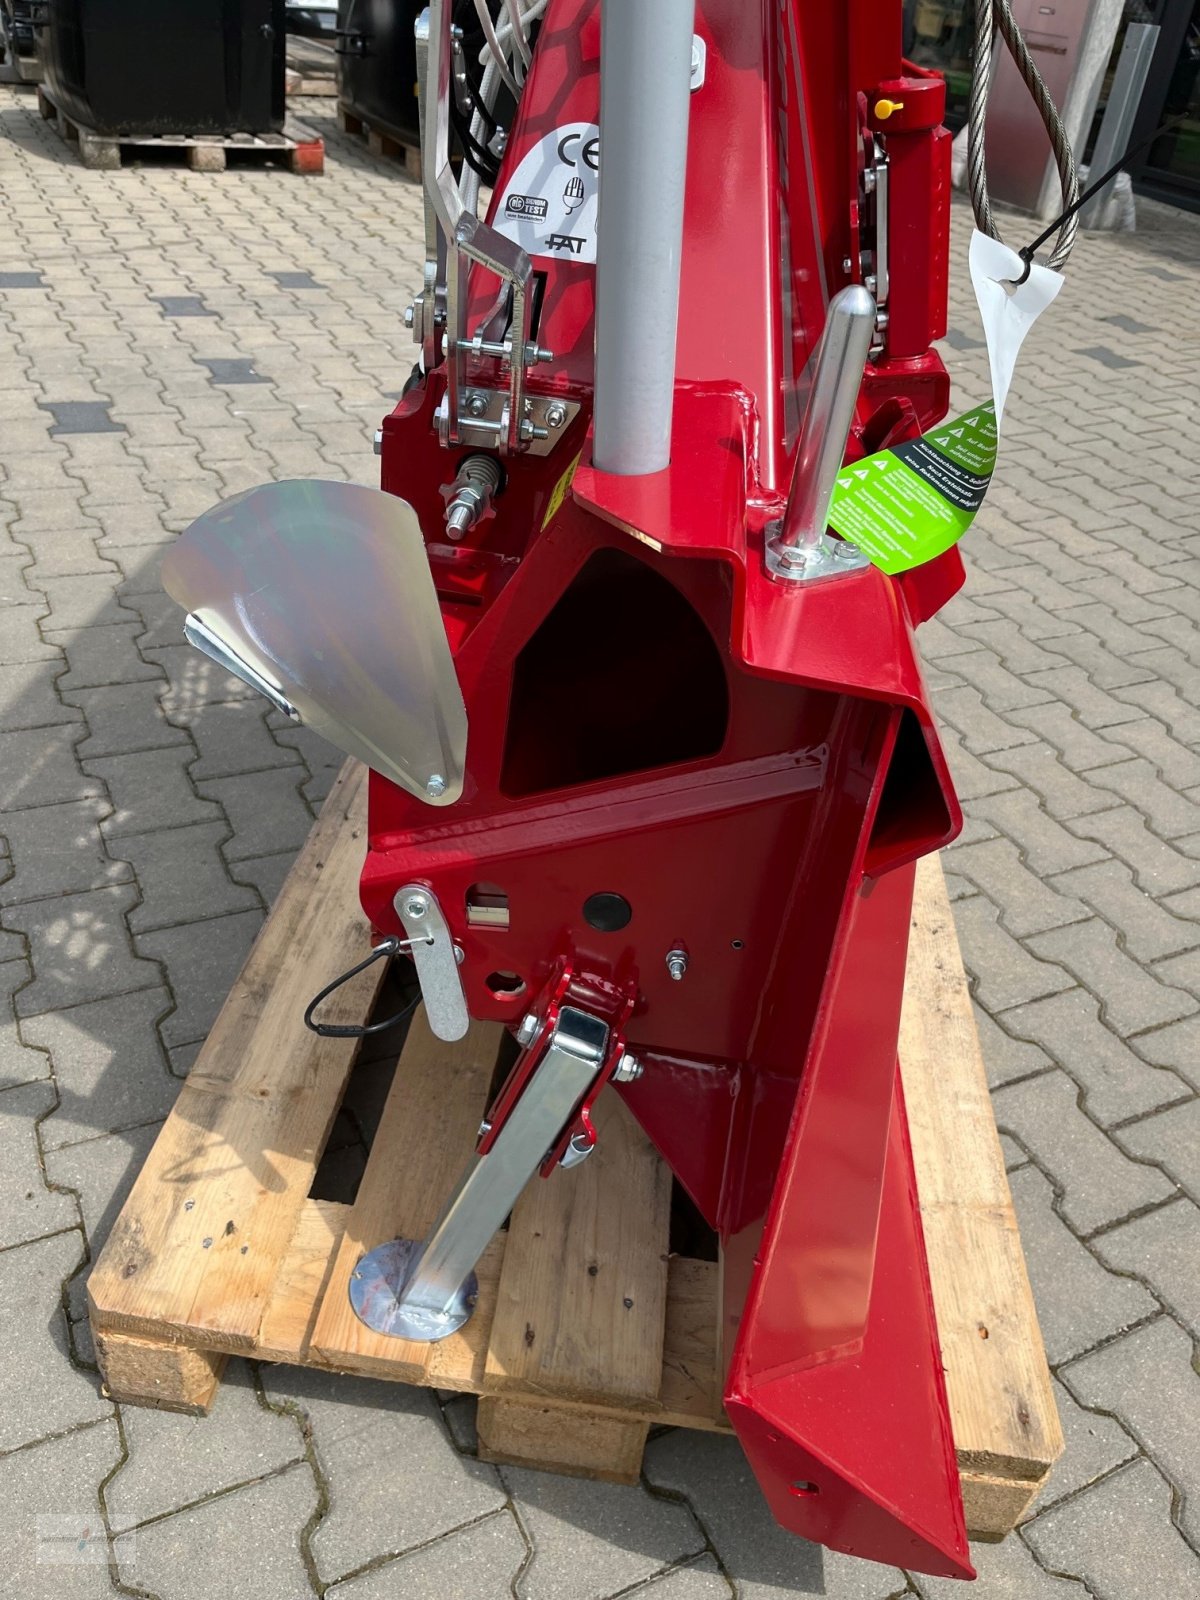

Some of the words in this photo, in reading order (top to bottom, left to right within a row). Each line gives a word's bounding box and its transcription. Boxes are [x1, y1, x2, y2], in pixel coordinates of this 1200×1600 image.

[557, 133, 600, 170] CE
[524, 204, 545, 215] TEST
[544, 233, 587, 254] FAT
[904, 454, 921, 469] keine
[919, 442, 962, 476] Nichtbeachtung
[926, 464, 942, 478] Nach
